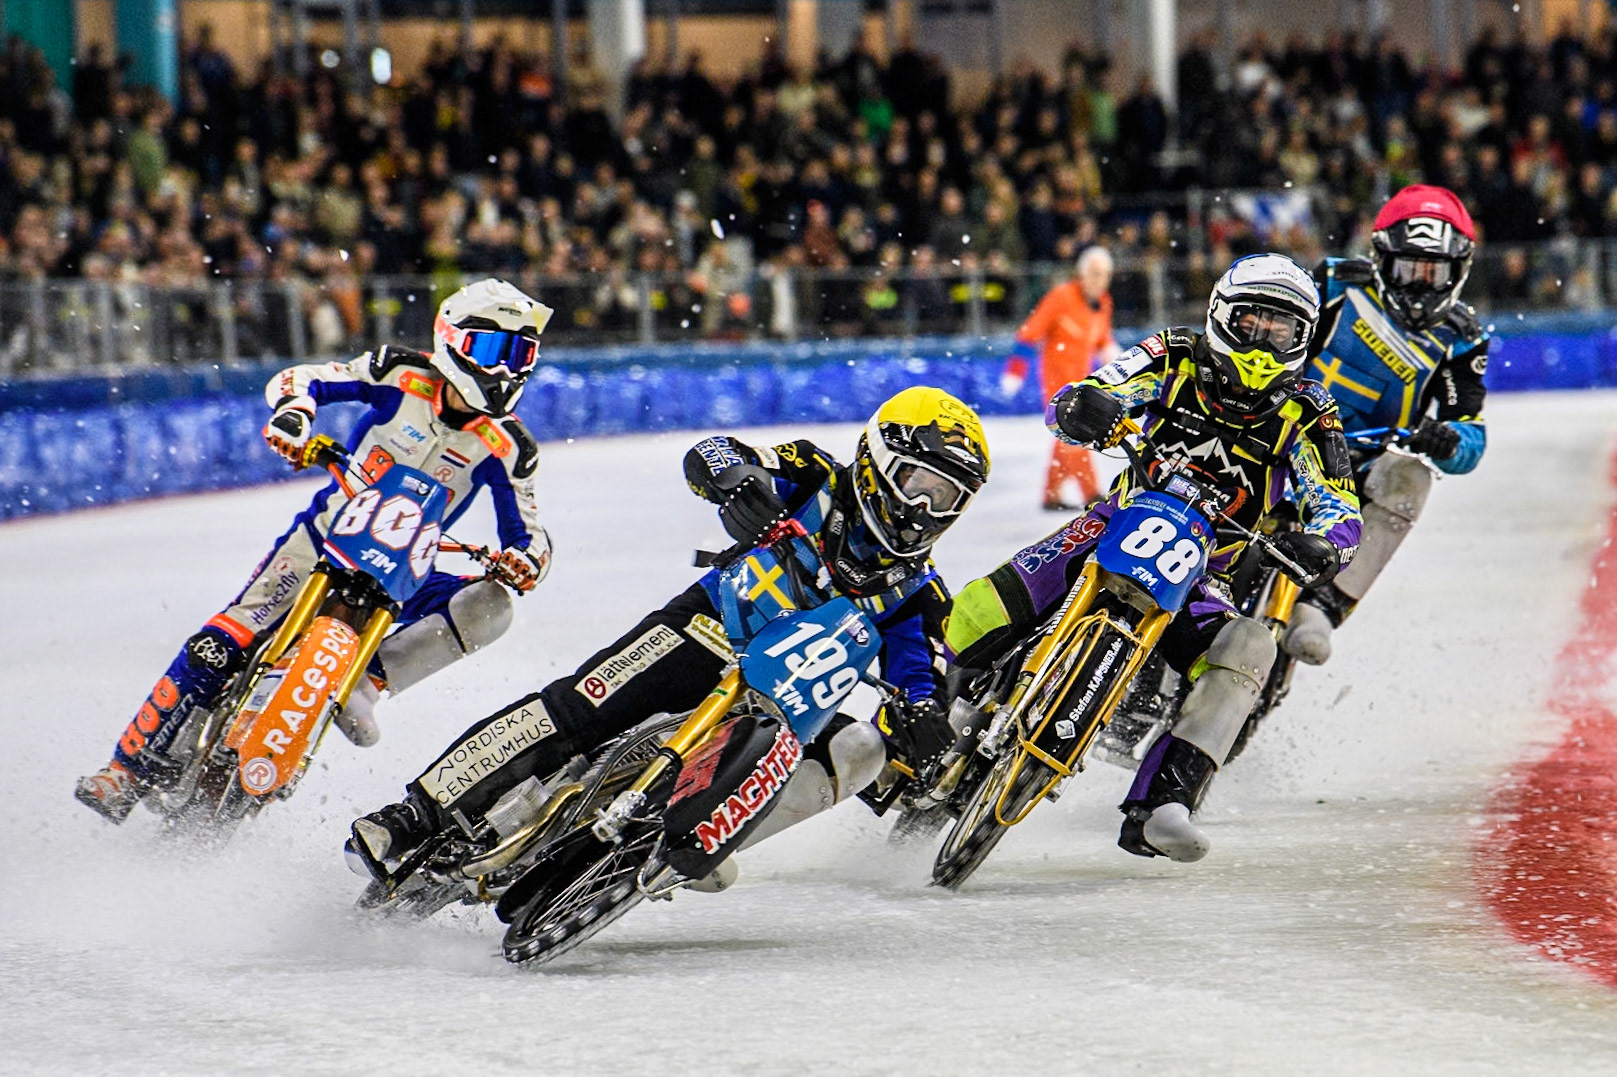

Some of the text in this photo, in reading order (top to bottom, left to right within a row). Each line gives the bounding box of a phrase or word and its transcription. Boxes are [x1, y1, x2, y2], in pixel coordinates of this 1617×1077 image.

[1352, 317, 1419, 386] SWEDEN
[360, 547, 398, 575] FIM
[1119, 516, 1201, 585] 88
[1130, 565, 1160, 588] FIM
[250, 570, 300, 626] Horses2fly
[596, 626, 676, 683] lättelement
[763, 621, 860, 710] 199
[120, 674, 181, 757] 800
[1068, 688, 1095, 722] Stefan
[434, 717, 553, 805] CENTRUMHUS
[437, 707, 534, 783] NORDISKA
[693, 727, 804, 855] MACHTEC
